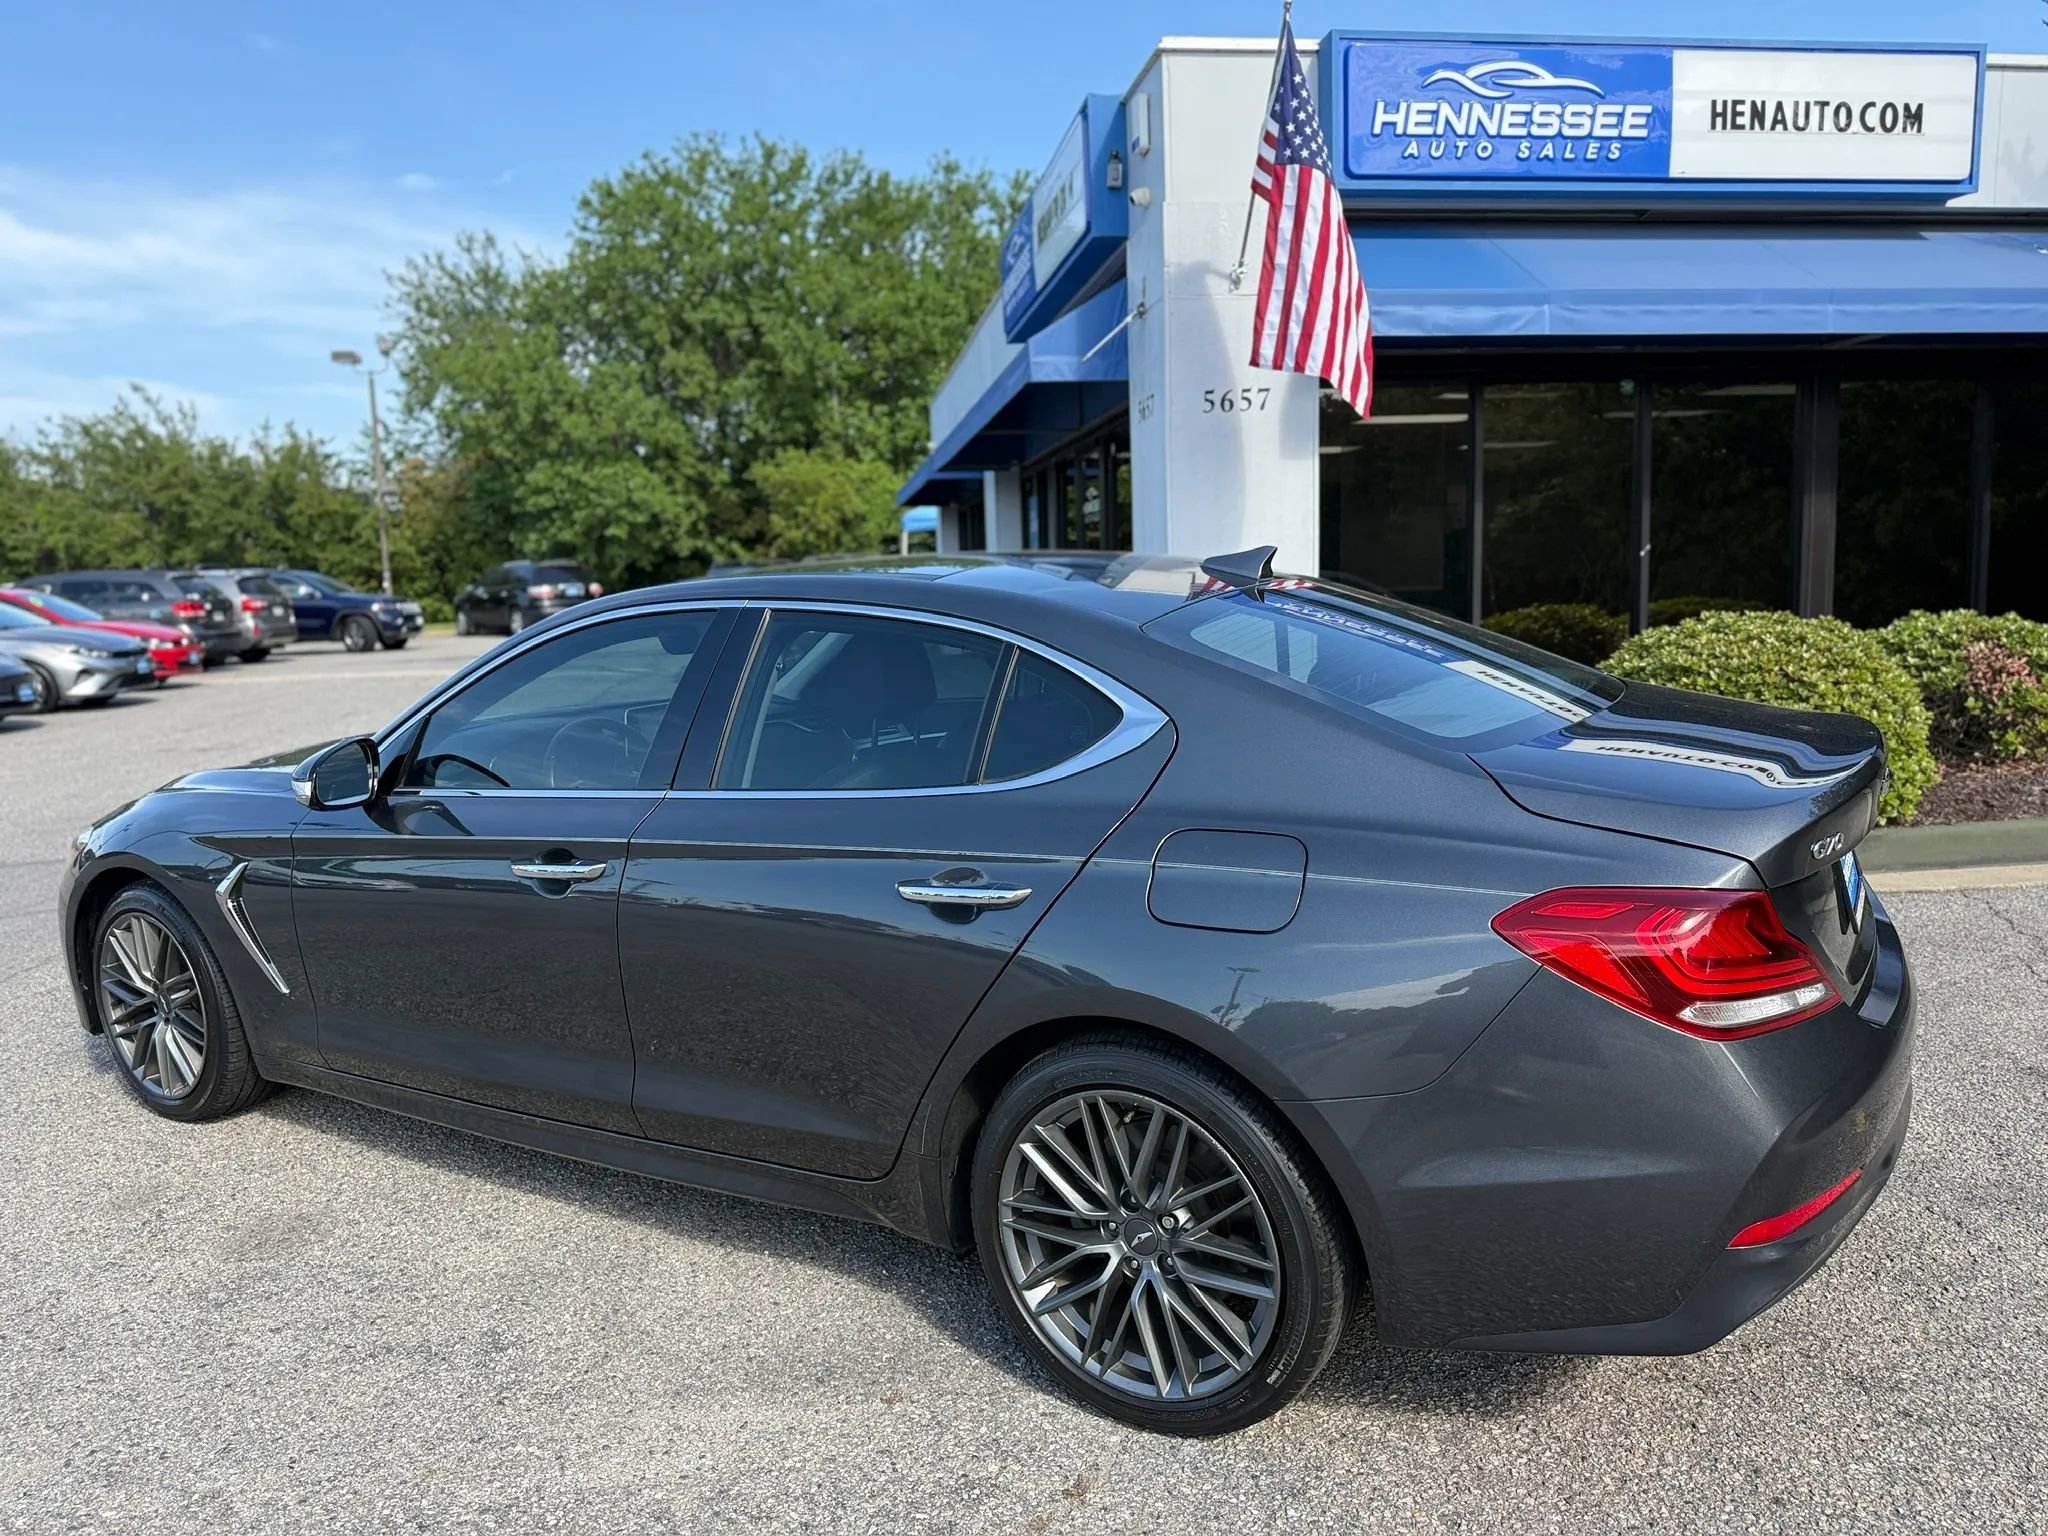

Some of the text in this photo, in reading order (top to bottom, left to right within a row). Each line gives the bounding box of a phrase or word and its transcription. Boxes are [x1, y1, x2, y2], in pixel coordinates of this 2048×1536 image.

[1372, 100, 1653, 138] HENNESSEE
[1403, 139, 1622, 160] AUTO SALES
[1202, 387, 1271, 414] 5657
[1811, 832, 1845, 860] G70
